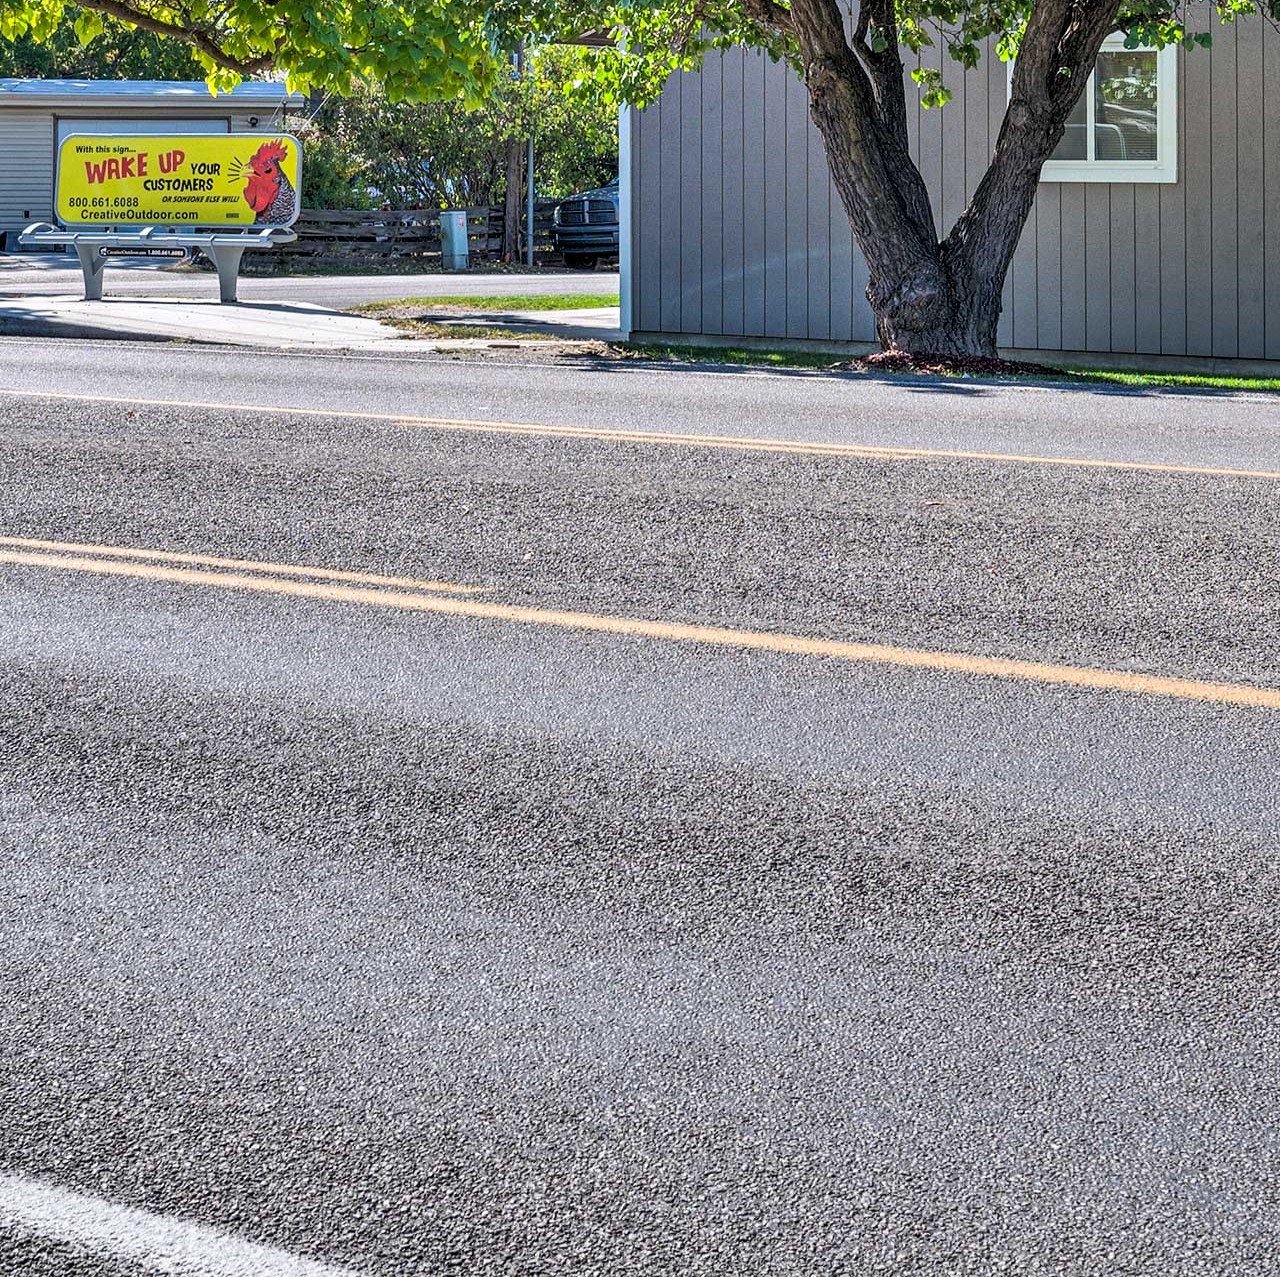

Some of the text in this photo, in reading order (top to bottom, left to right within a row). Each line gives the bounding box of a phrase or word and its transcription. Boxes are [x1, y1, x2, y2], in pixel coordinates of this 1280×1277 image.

[75, 145, 136, 155] With this sign...
[84, 149, 221, 185] WAKE UP YOUR
[143, 178, 214, 191] CUSTOMERS
[68, 197, 139, 208] 800.661.6088
[161, 195, 240, 203] OR SOMEONE ELSE WILL!
[80, 209, 199, 220] CreativeOutdoor.com
